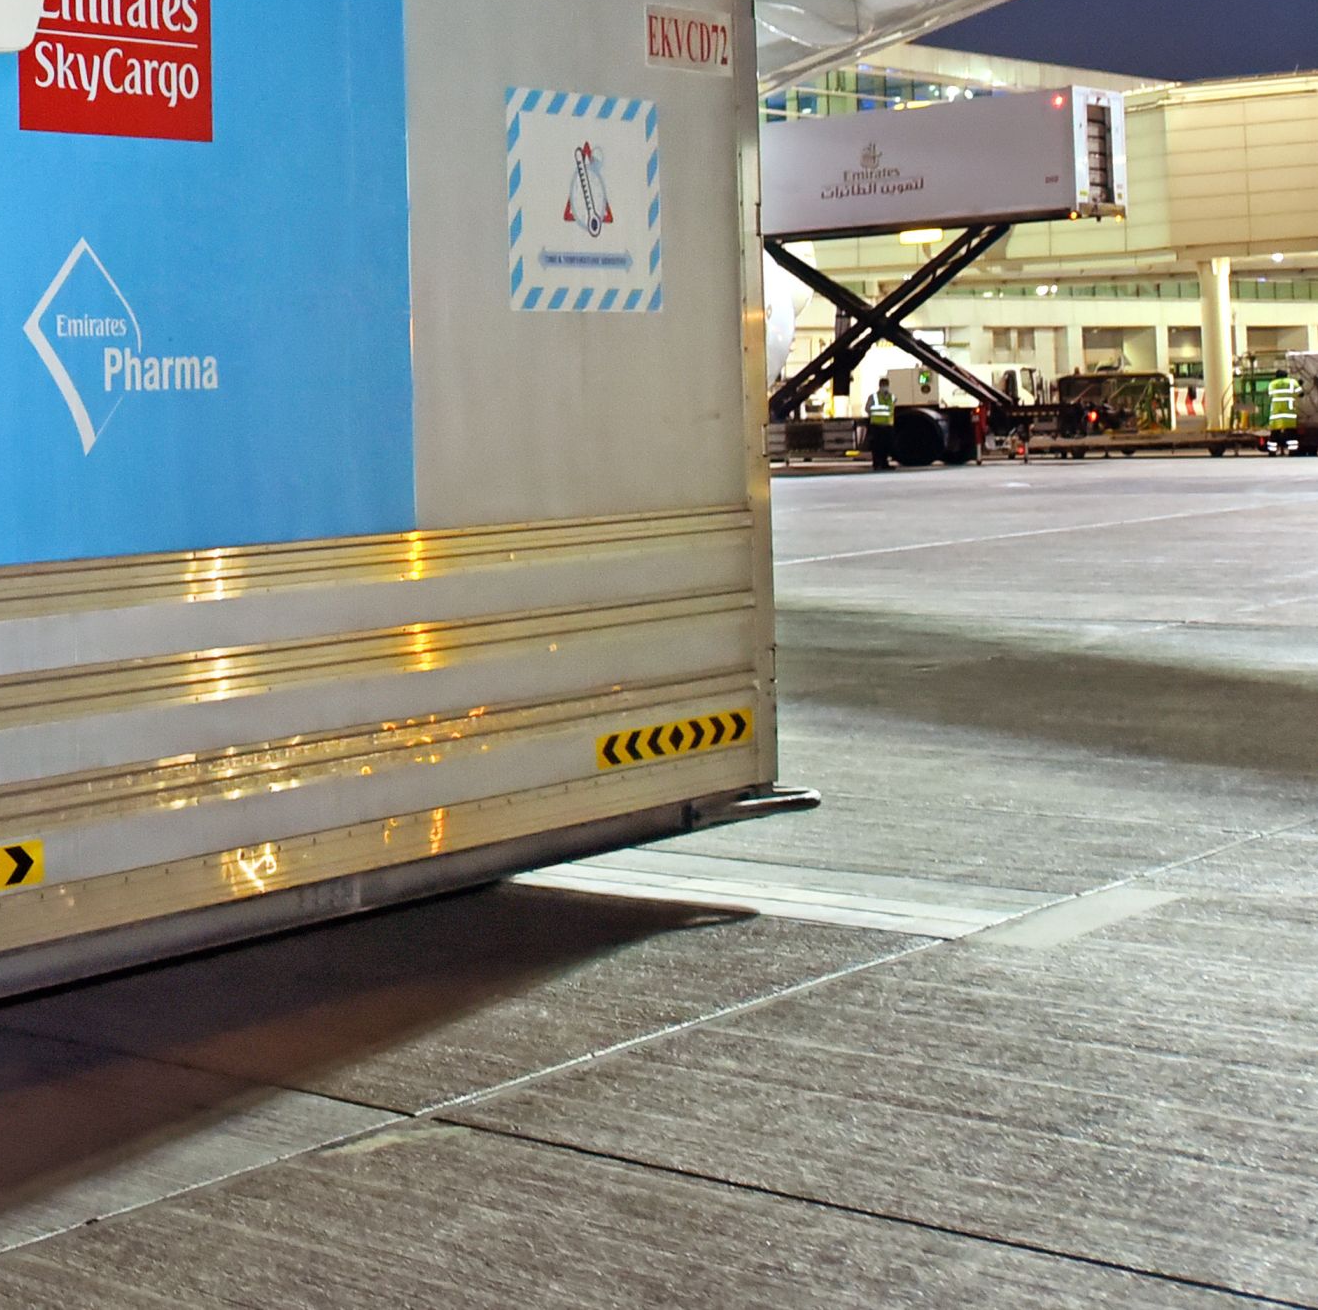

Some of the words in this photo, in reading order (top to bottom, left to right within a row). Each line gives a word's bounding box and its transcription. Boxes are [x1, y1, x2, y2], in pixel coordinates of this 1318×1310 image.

[648, 14, 729, 66] EKVCD72
[34, 40, 200, 108] SkyCargo
[55, 313, 128, 338] Emirates
[103, 347, 219, 392] Pharma
